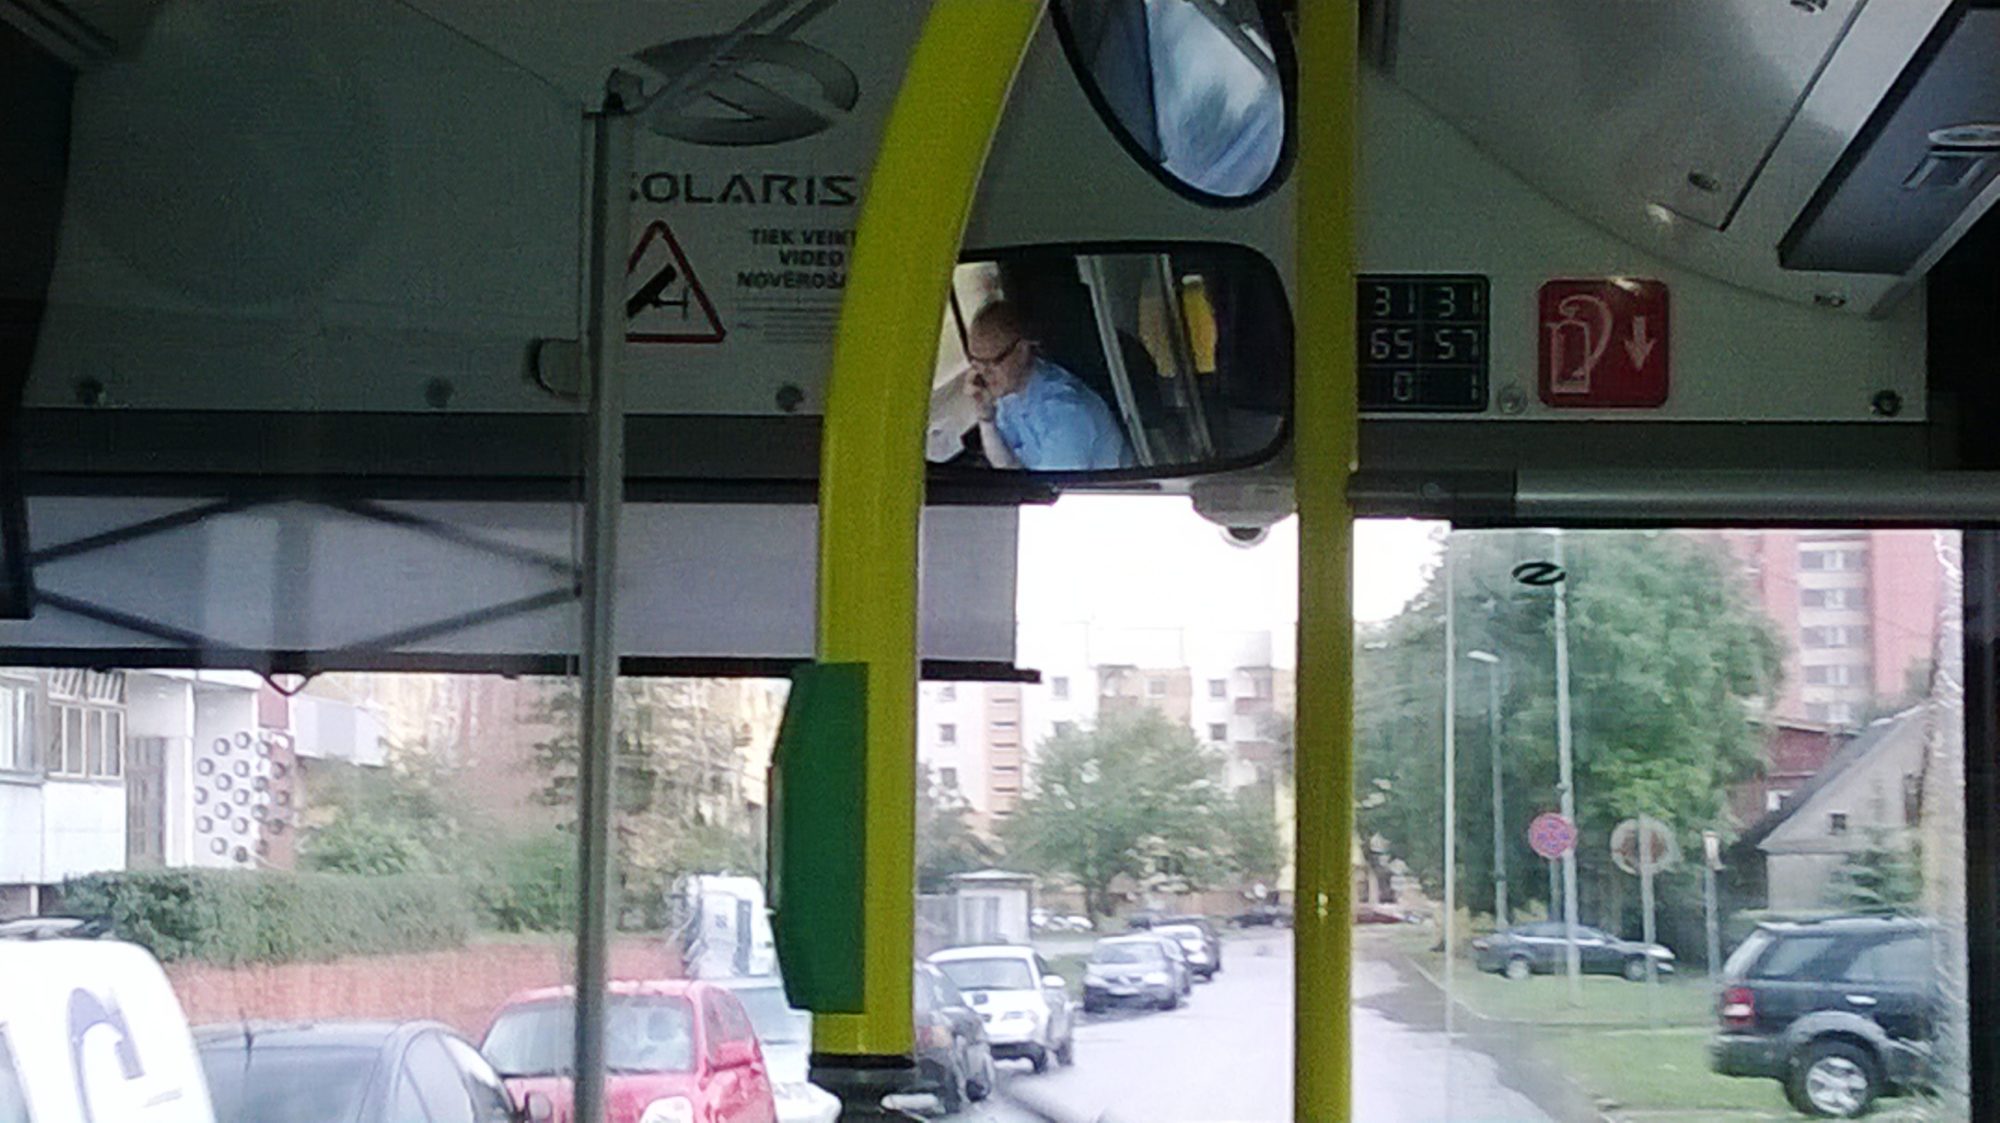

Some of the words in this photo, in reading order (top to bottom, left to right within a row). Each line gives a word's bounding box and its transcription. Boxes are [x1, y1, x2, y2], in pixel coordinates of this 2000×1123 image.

[629, 171, 858, 206] OLARIS
[750, 228, 795, 246] TIEK
[778, 249, 845, 267] VIDEO
[1374, 285, 1415, 317] 31
[1438, 285, 1479, 318] 31
[1369, 327, 1415, 360] 65
[1433, 327, 1480, 360] 57
[1392, 370, 1414, 402] 0
